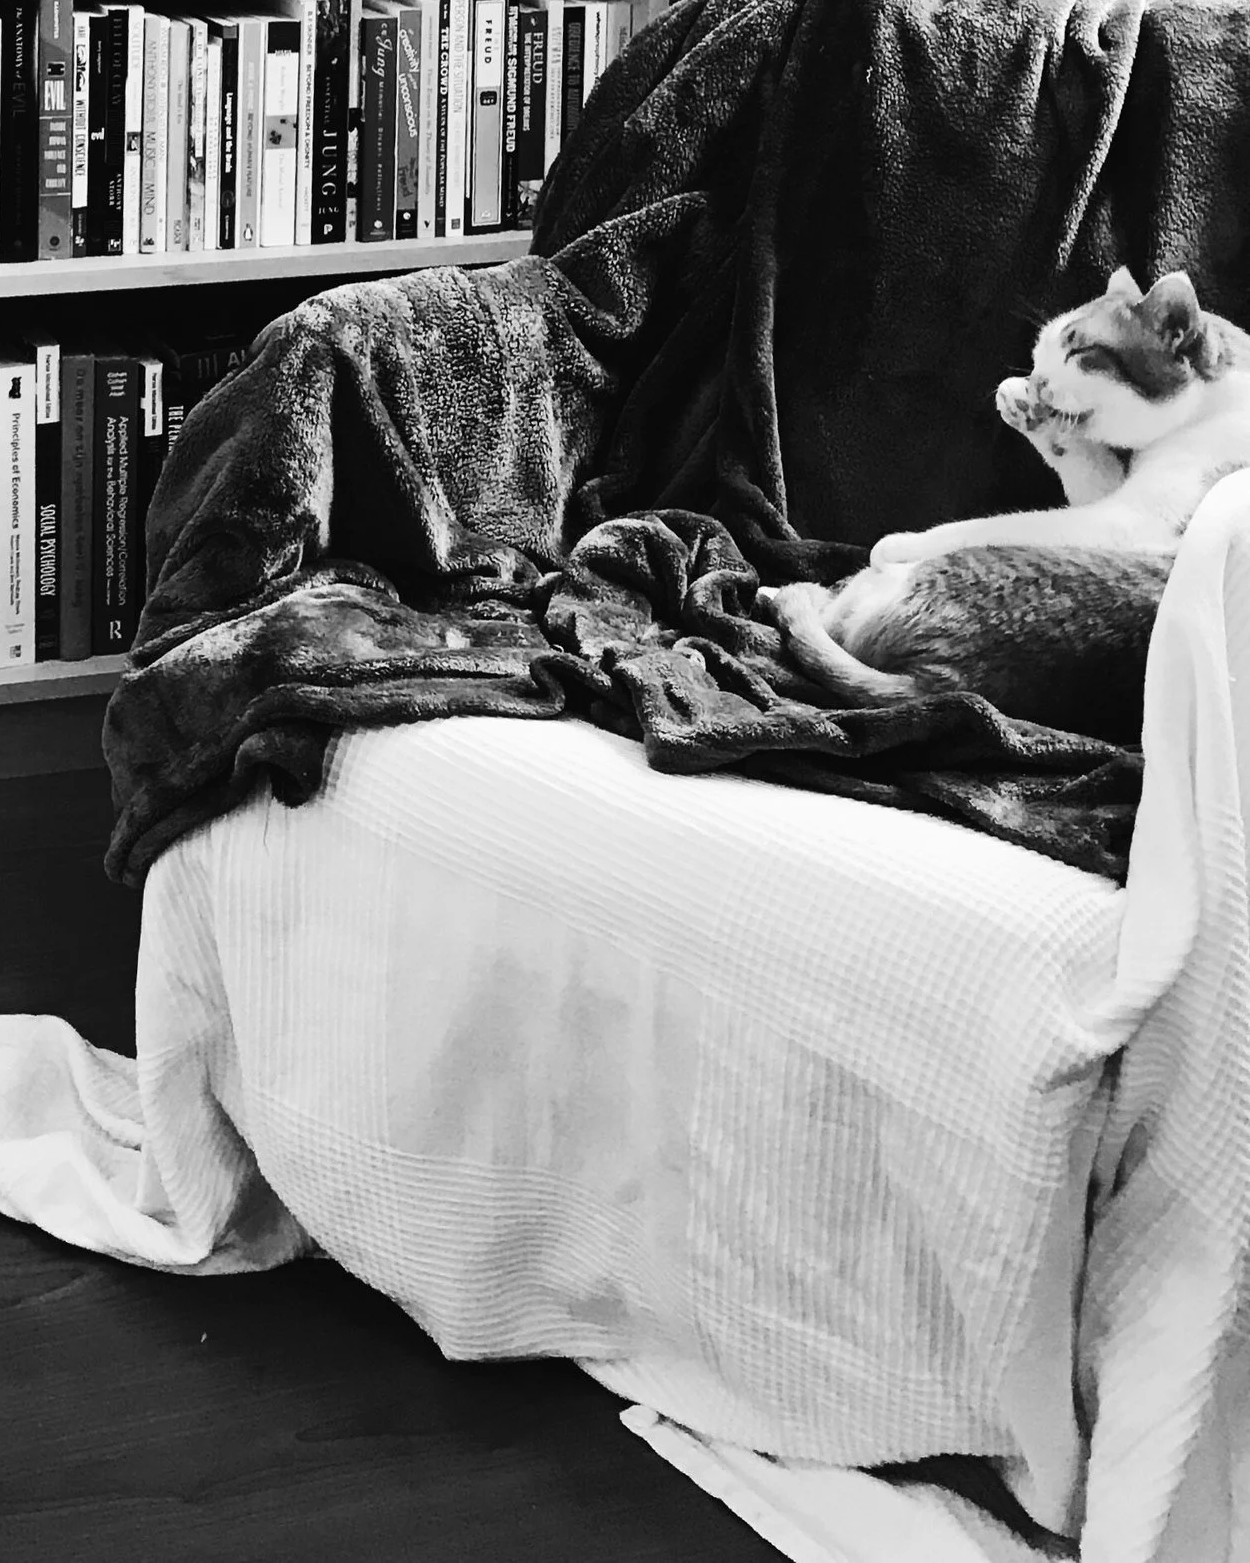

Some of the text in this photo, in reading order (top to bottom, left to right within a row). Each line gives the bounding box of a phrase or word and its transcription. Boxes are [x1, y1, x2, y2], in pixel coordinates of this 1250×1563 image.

[372, 36, 393, 78] Jung
[483, 19, 493, 65] FREUD
[531, 32, 544, 83] FREUD
[506, 58, 518, 152] SIGMUND FREUD
[74, 99, 87, 176] WITHOUT CONSCIENCE
[321, 130, 338, 196] JUNG
[11, 413, 22, 462] Principles
[12, 464, 22, 475] of
[11, 478, 22, 529] Economics
[39, 504, 56, 596] SOCIAL PSYCHOLOGY
